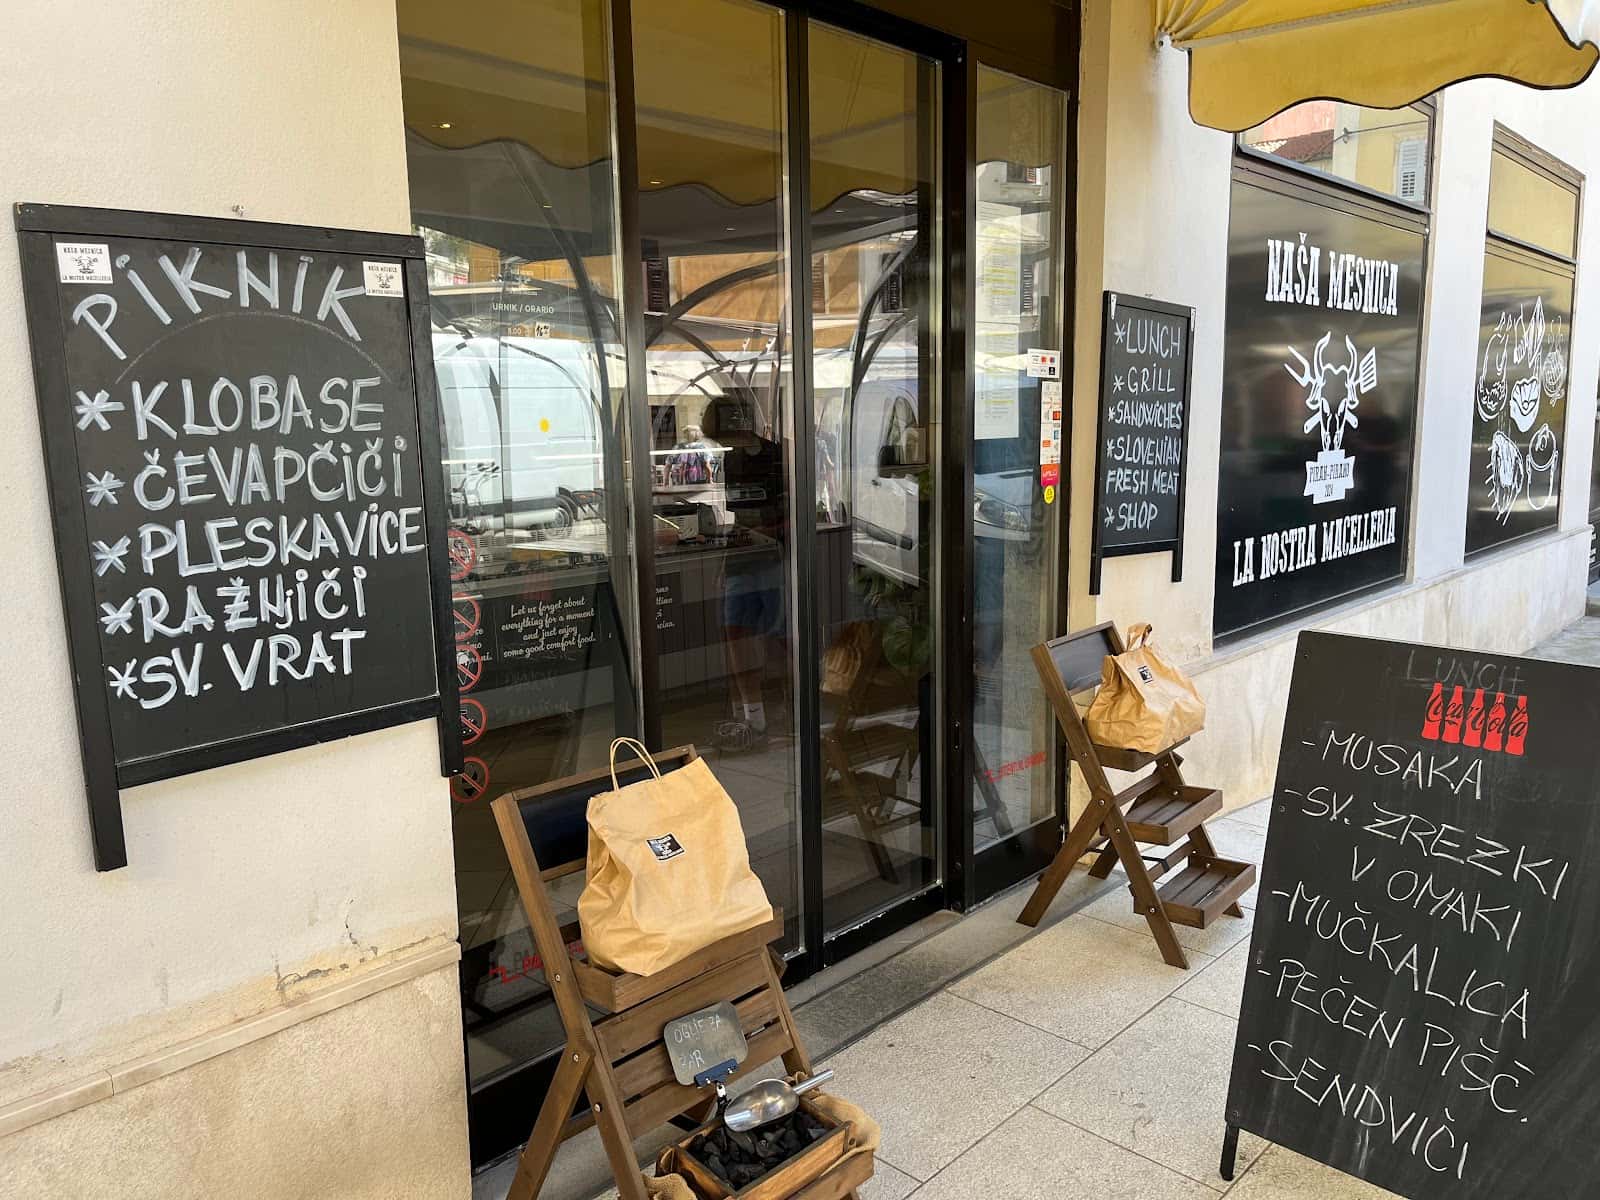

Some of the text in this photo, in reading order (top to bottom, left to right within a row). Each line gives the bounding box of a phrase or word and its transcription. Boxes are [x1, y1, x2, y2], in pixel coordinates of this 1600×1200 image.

[1264, 232, 1399, 317] NAŠA MESNICA
[492, 303, 518, 312] URNIK
[524, 304, 555, 314] ORARIO
[1126, 318, 1181, 359] LUNCH
[132, 374, 385, 441] KLOBASE
[1105, 467, 1180, 496] FRESH MEAT
[1116, 500, 1158, 532] SHOP
[1232, 506, 1397, 587] LA NOSTRA MACELLERIA
[501, 615, 544, 632] everything
[545, 614, 557, 628] for
[566, 608, 595, 621] moment
[511, 604, 526, 618] Let
[538, 601, 562, 616] forget
[564, 596, 585, 608] about
[503, 648, 524, 658] some
[525, 642, 545, 658] good
[546, 634, 576, 652] comfort
[577, 632, 597, 648] food.
[523, 624, 578, 643] and just enjoy
[139, 627, 367, 710] SV. VRAT
[1406, 649, 1525, 694] LUNCH
[1363, 801, 1569, 900] ZREZKI
[1352, 846, 1522, 952] V OMAKI
